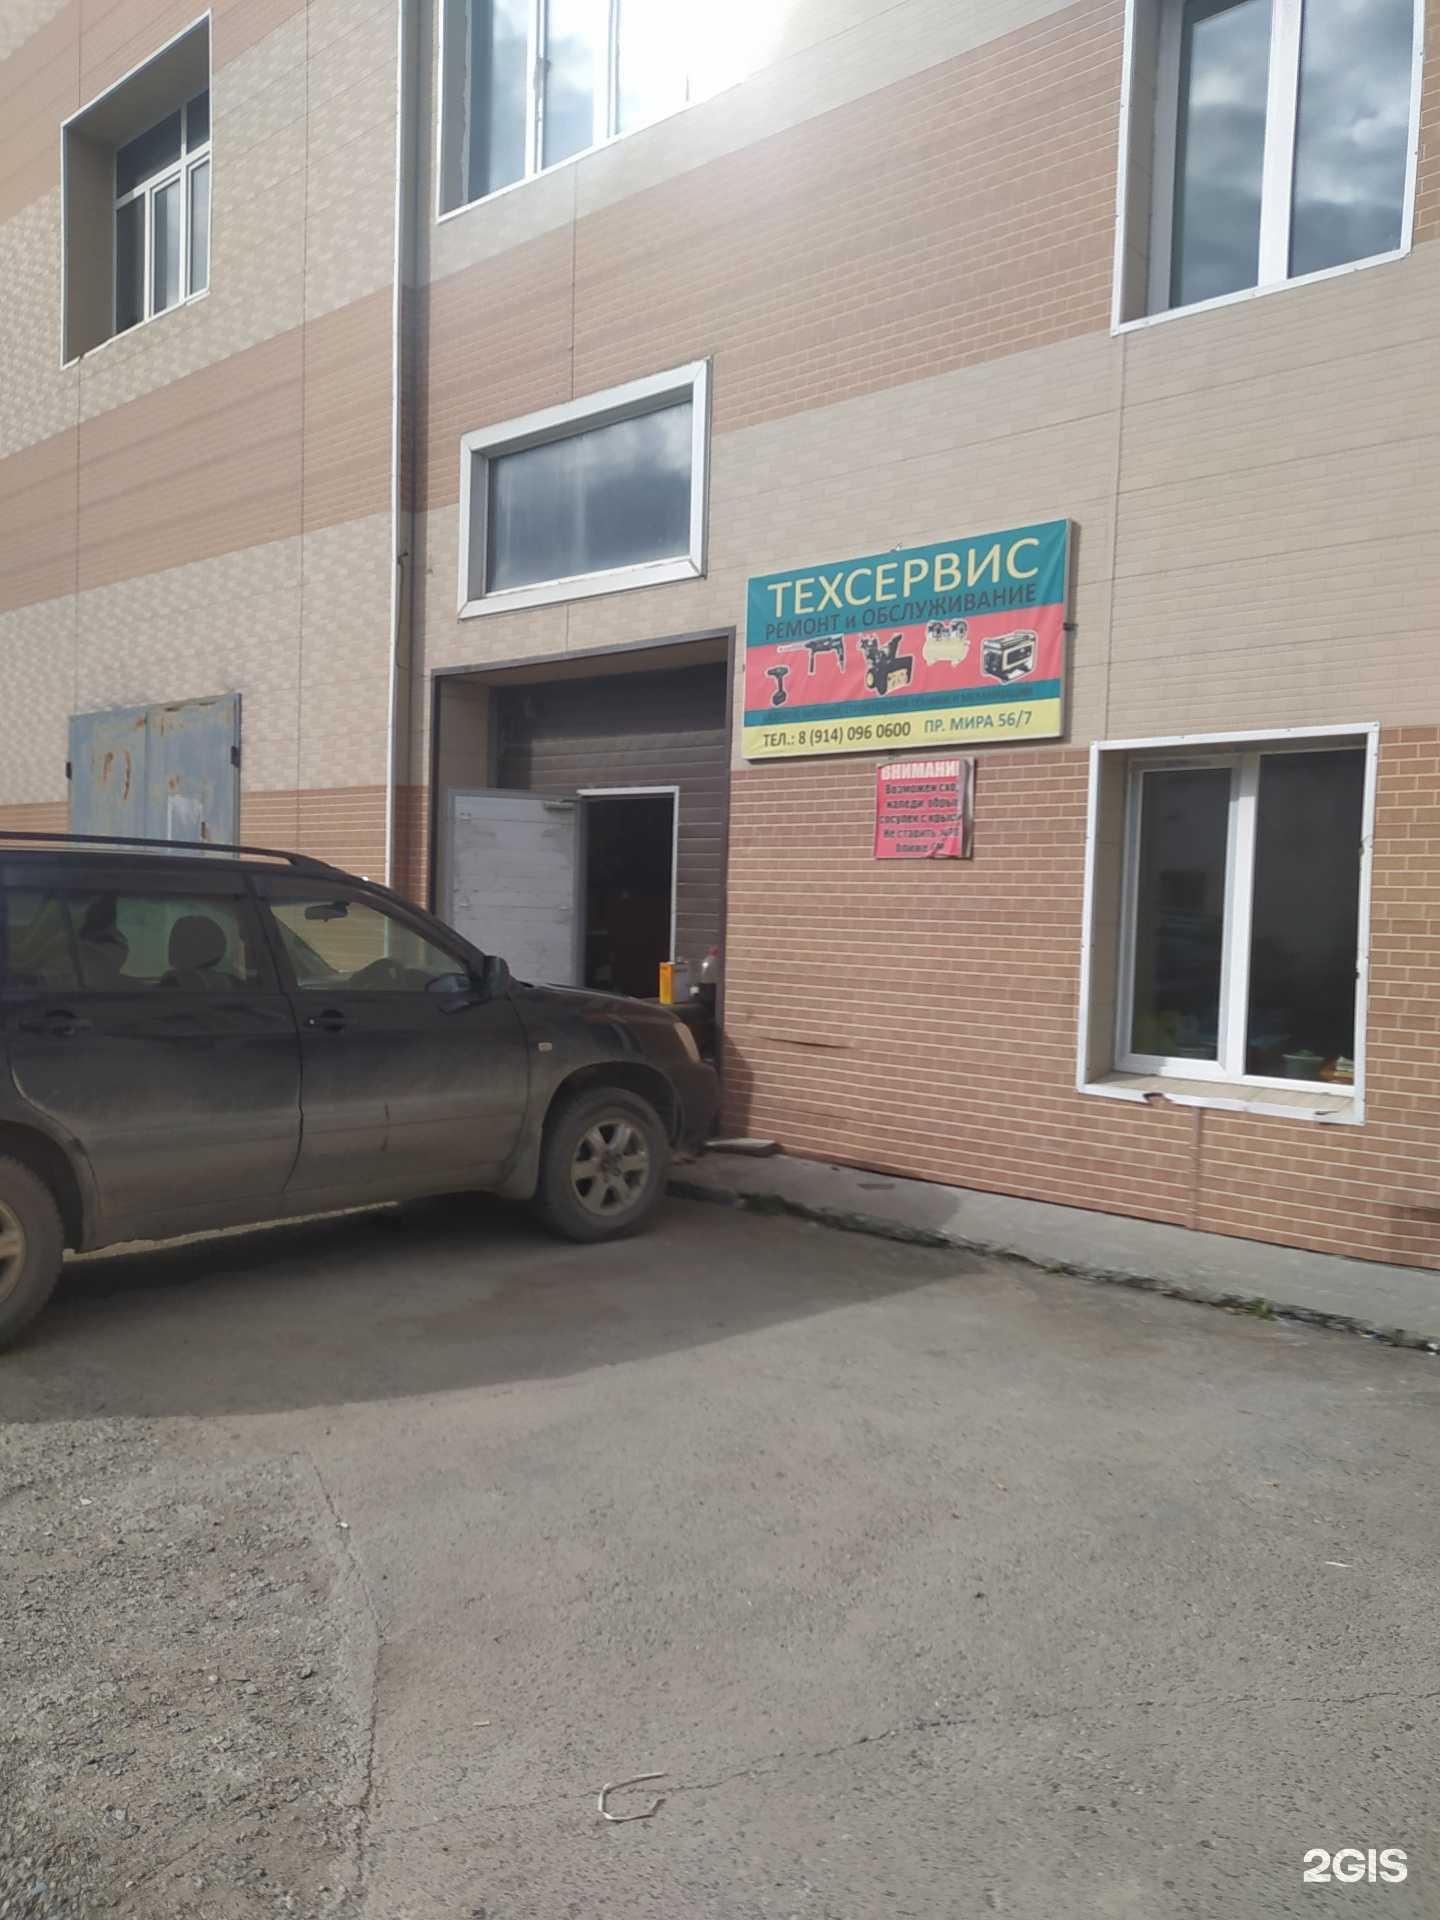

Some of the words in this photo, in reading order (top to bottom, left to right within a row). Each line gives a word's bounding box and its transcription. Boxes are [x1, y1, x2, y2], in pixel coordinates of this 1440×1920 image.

[768, 537, 1040, 618] ТЕХСЕРВИС
[765, 613, 840, 640] РЕМОНТ
[862, 583, 1037, 627] ОБСЛУЖИВАНИЕ
[798, 730, 807, 744] 8
[809, 725, 844, 746] (914)
[847, 723, 873, 739] 096
[878, 720, 911, 737] 0600
[924, 718, 945, 733] ПР.
[950, 713, 993, 731] МИРА
[998, 709, 1033, 729] 56/7
